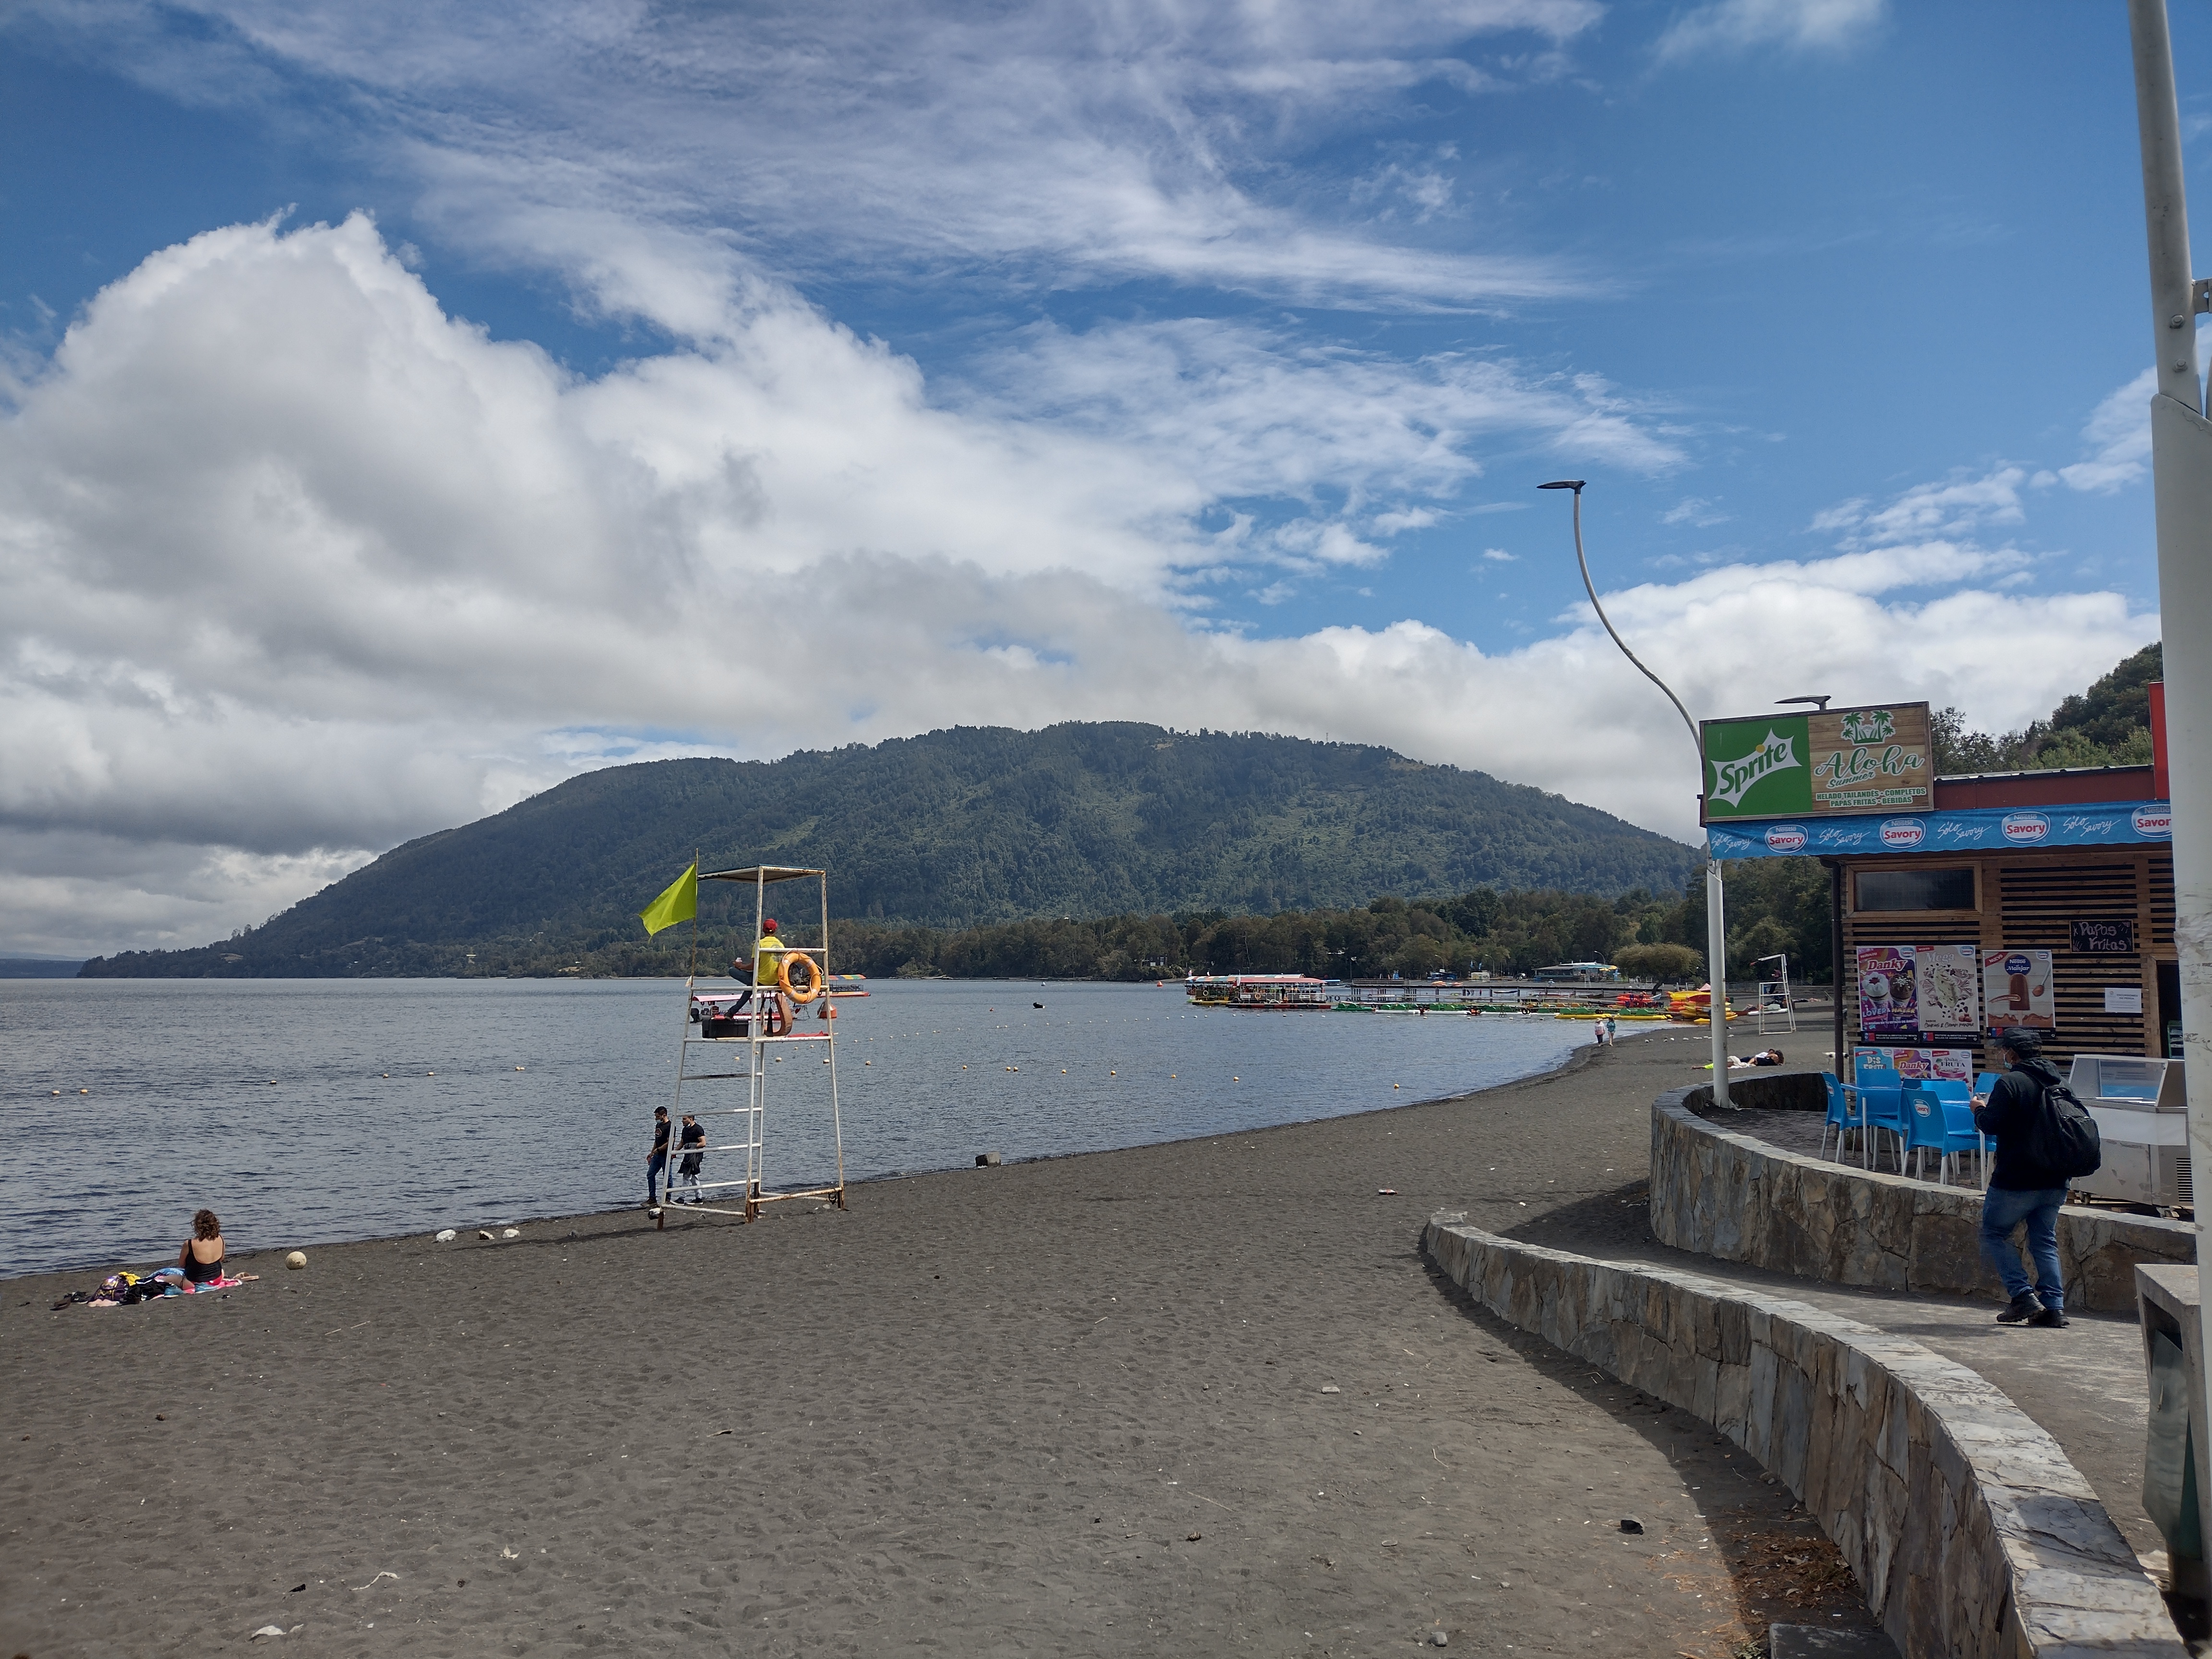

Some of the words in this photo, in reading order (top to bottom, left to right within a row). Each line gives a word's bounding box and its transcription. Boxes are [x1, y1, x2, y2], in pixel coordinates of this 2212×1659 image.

[1815, 745, 1924, 778] Aloha
[1719, 743, 1788, 795] Sprite
[1827, 772, 1875, 787] Summer
[1844, 790, 1879, 799] TAILANDÉS
[1885, 788, 1925, 797] COMPLETOS
[2007, 825, 2045, 834] Savory
[2063, 816, 2089, 834] Sólo
[2080, 819, 2121, 837] Savory
[2138, 818, 2171, 828] Savor
[1818, 828, 1843, 844] Sólo
[1834, 831, 1871, 847] Savory
[1884, 830, 1921, 840] Savory
[1937, 821, 1962, 839] Sólo
[1953, 825, 1992, 842] Savory
[1724, 837, 1756, 853] Savory
[1769, 836, 1803, 845] Savory
[2079, 921, 2117, 936] Papas
[2089, 937, 2127, 950] Fritas
[1867, 959, 1908, 971] Danky
[1923, 952, 1955, 965] Mega
[1989, 954, 2003, 963] NUEVO
[1863, 1008, 1887, 1017] LOVER
[1899, 1061, 1928, 1070] Danky
